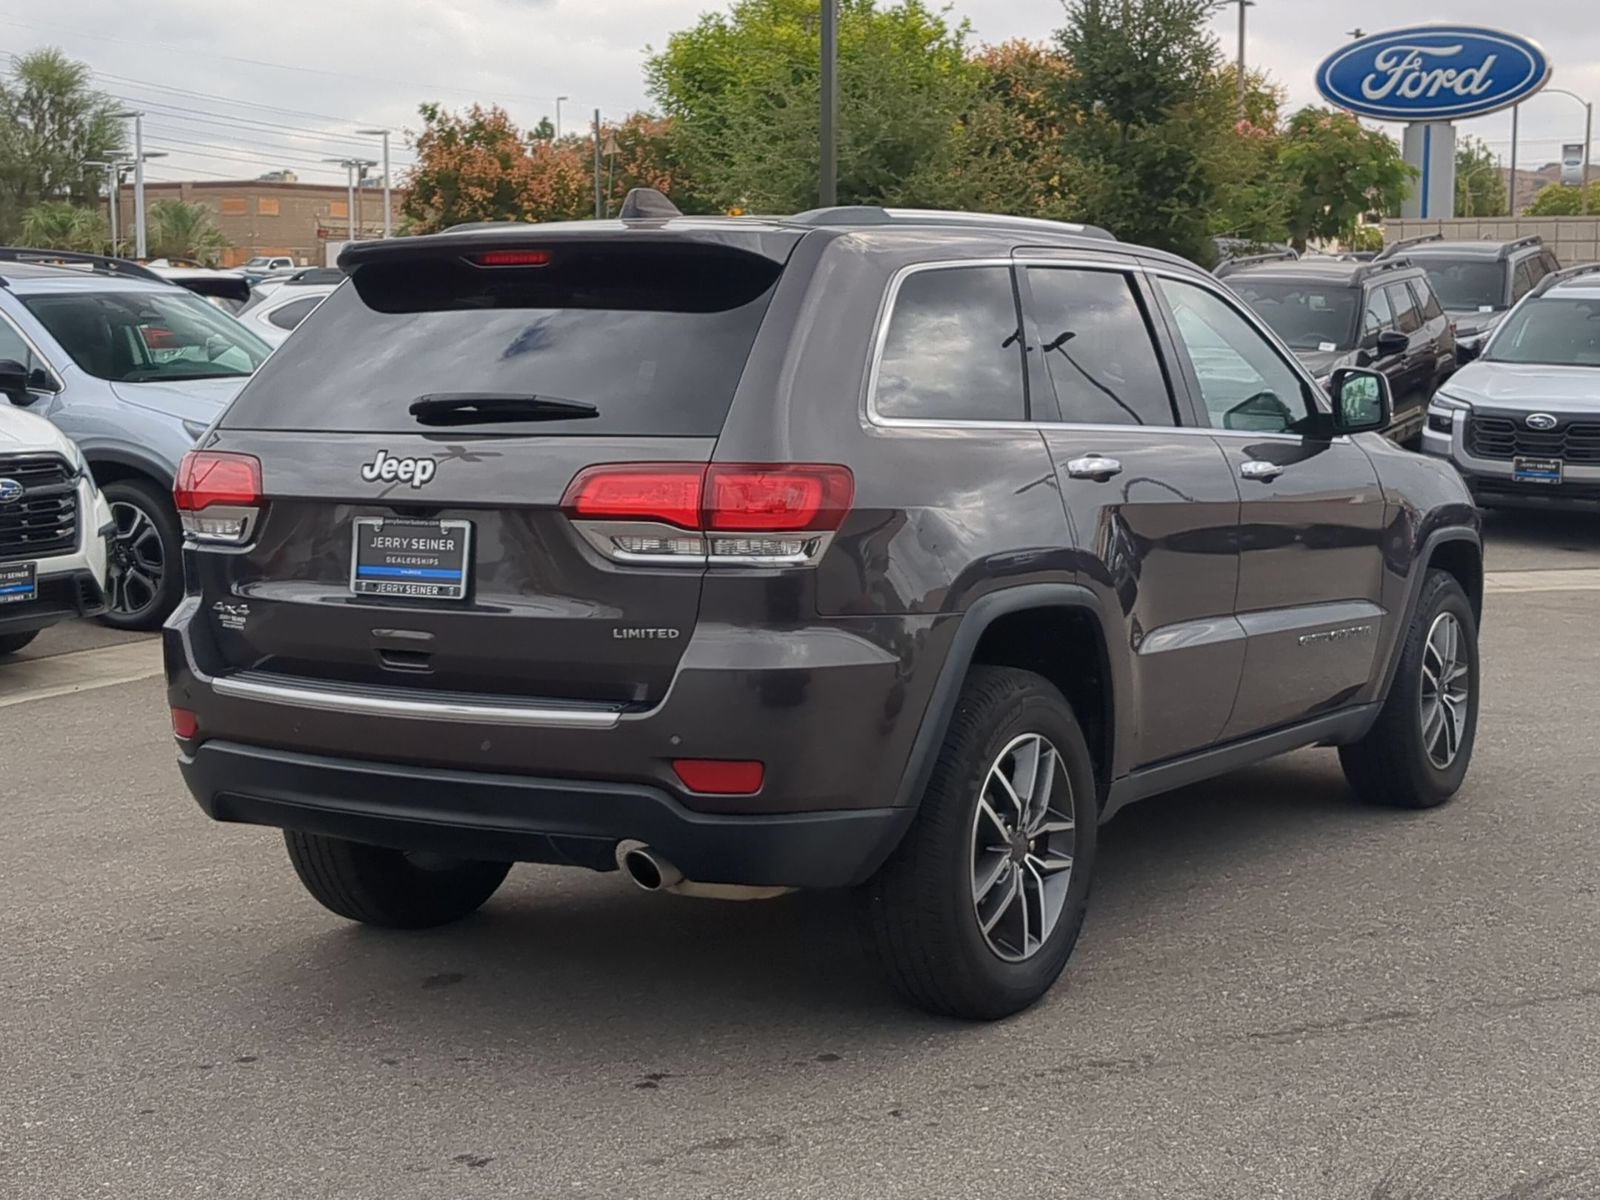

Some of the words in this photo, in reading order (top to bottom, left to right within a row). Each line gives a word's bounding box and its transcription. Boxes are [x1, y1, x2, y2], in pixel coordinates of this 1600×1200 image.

[1361, 44, 1498, 100] Ford
[361, 450, 437, 489] Jeep
[370, 536, 409, 548] JERRY
[411, 538, 454, 550] SEINER
[385, 556, 439, 565] DEALERSHIPS
[375, 583, 404, 593] JERRY
[405, 586, 439, 595] SEINER
[613, 628, 680, 639] LIMITED
